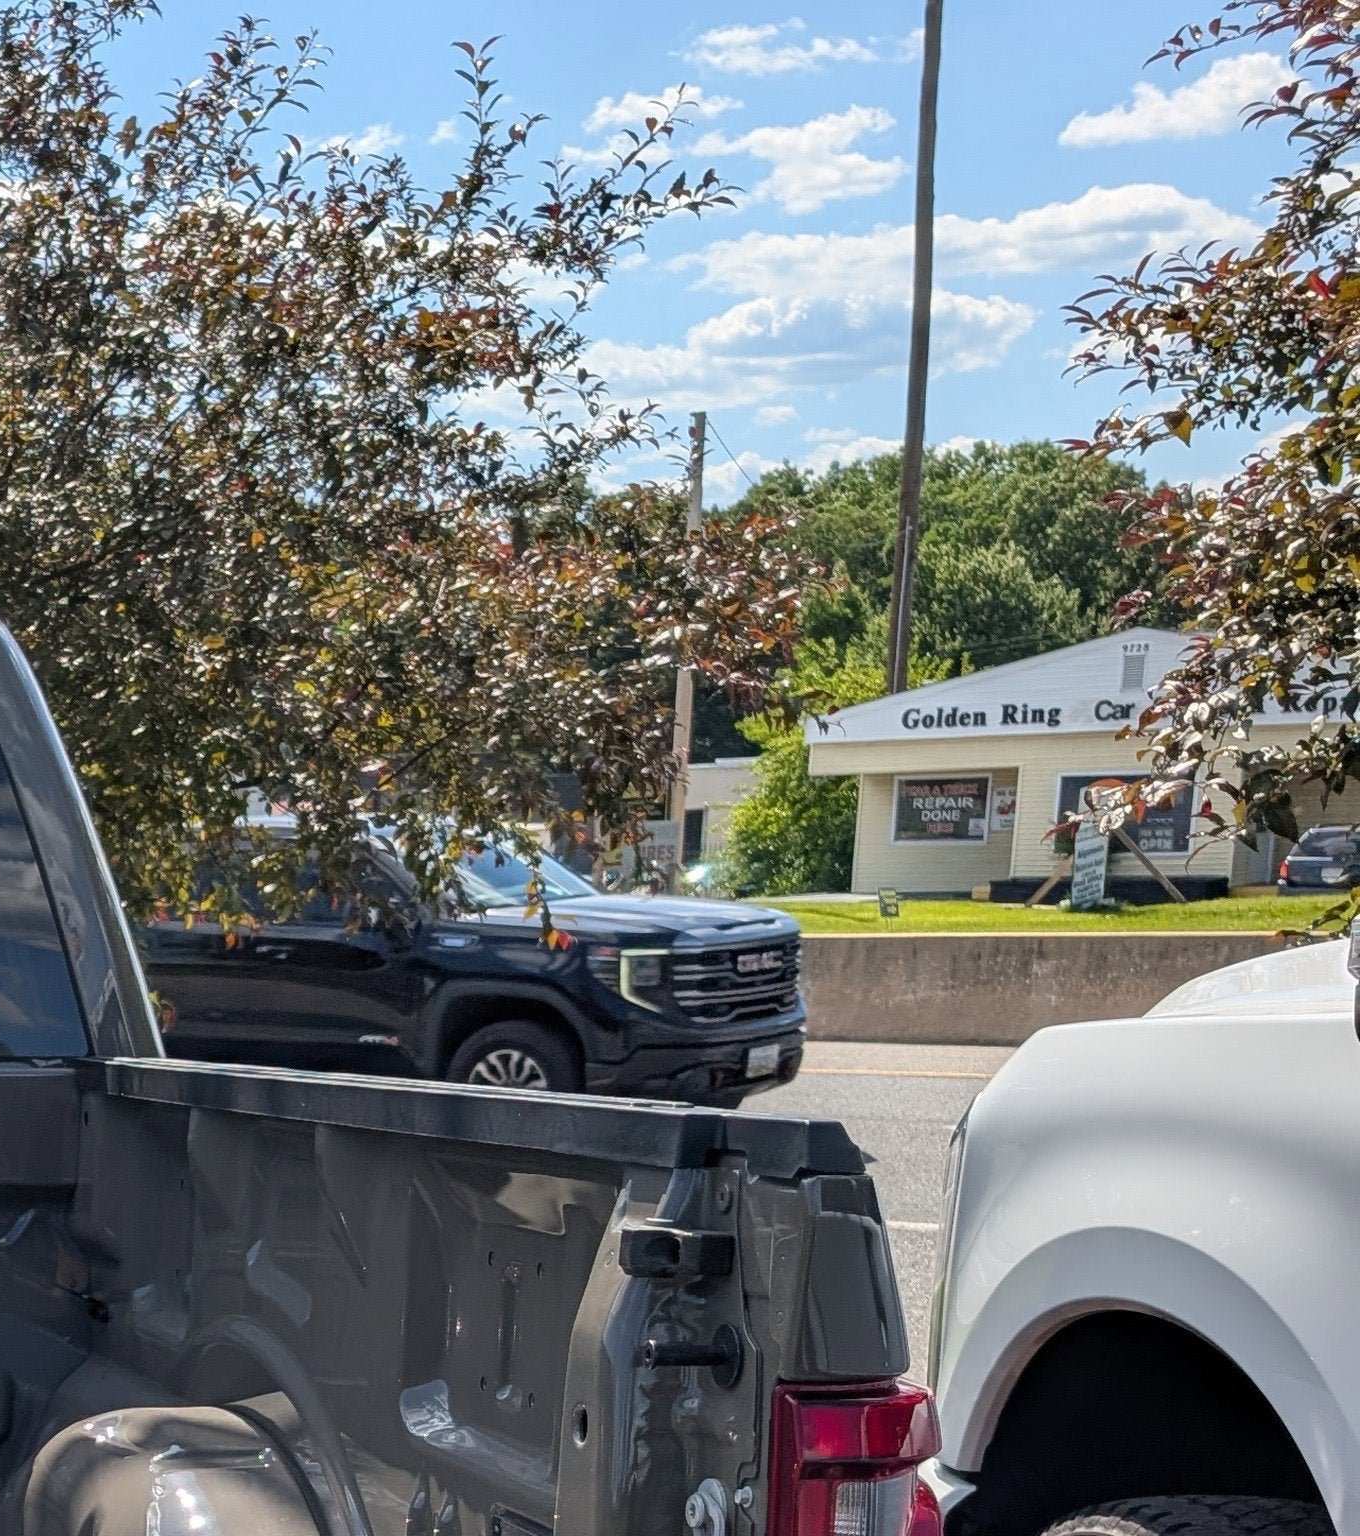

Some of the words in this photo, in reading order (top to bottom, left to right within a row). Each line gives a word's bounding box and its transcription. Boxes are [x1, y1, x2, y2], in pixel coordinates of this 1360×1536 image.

[901, 706, 987, 730] Golden
[999, 703, 1062, 727] Ring
[1094, 699, 1136, 722] Car
[912, 796, 974, 810] REPAIR
[921, 809, 962, 822] DONE
